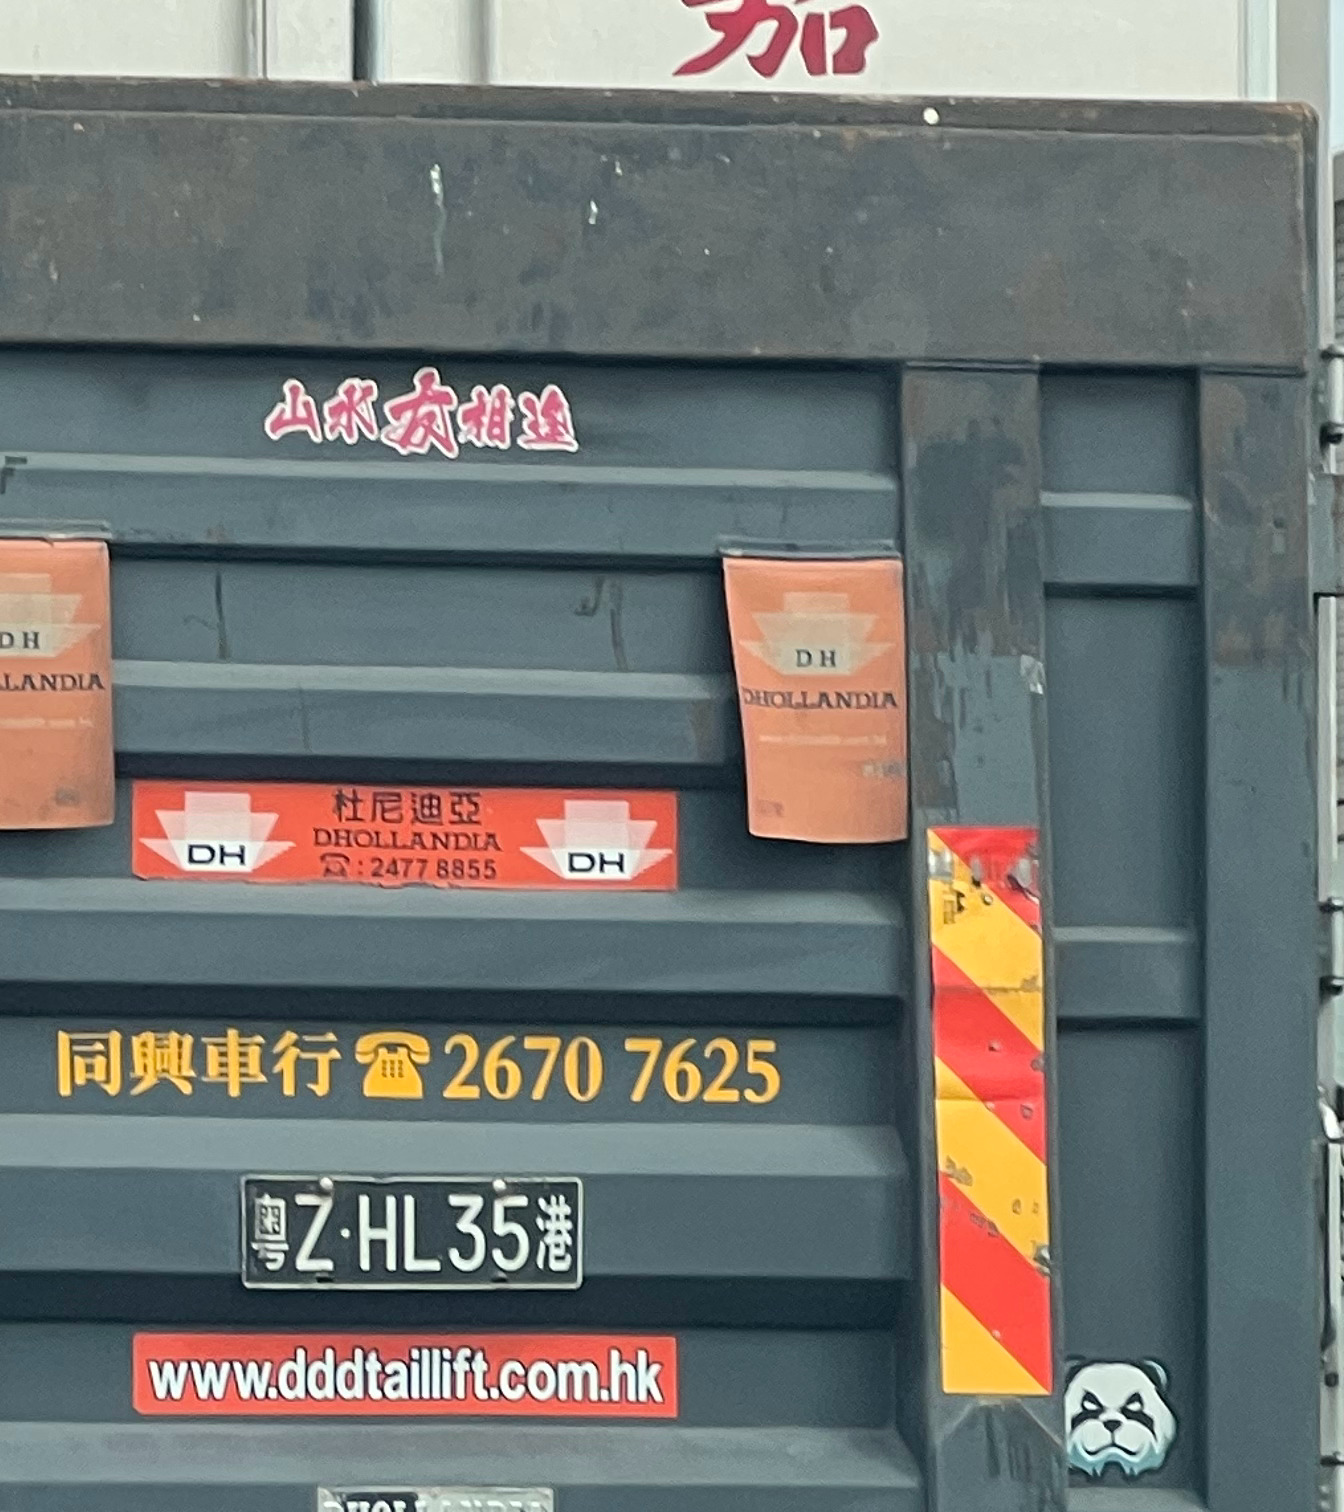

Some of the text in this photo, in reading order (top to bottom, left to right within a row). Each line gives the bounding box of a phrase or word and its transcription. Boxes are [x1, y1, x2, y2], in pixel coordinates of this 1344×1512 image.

[743, 687, 898, 710] DHOLLANDIA
[332, 788, 483, 825] 杜尼迪亞
[312, 828, 503, 852] DHOLLANDIA
[187, 843, 247, 866] DH
[567, 851, 626, 874] DH
[436, 857, 498, 880] 8855
[56, 1028, 782, 1104] 同興車行 2670 7625
[149, 1347, 664, 1404] www.dddtaillift.com.hk
